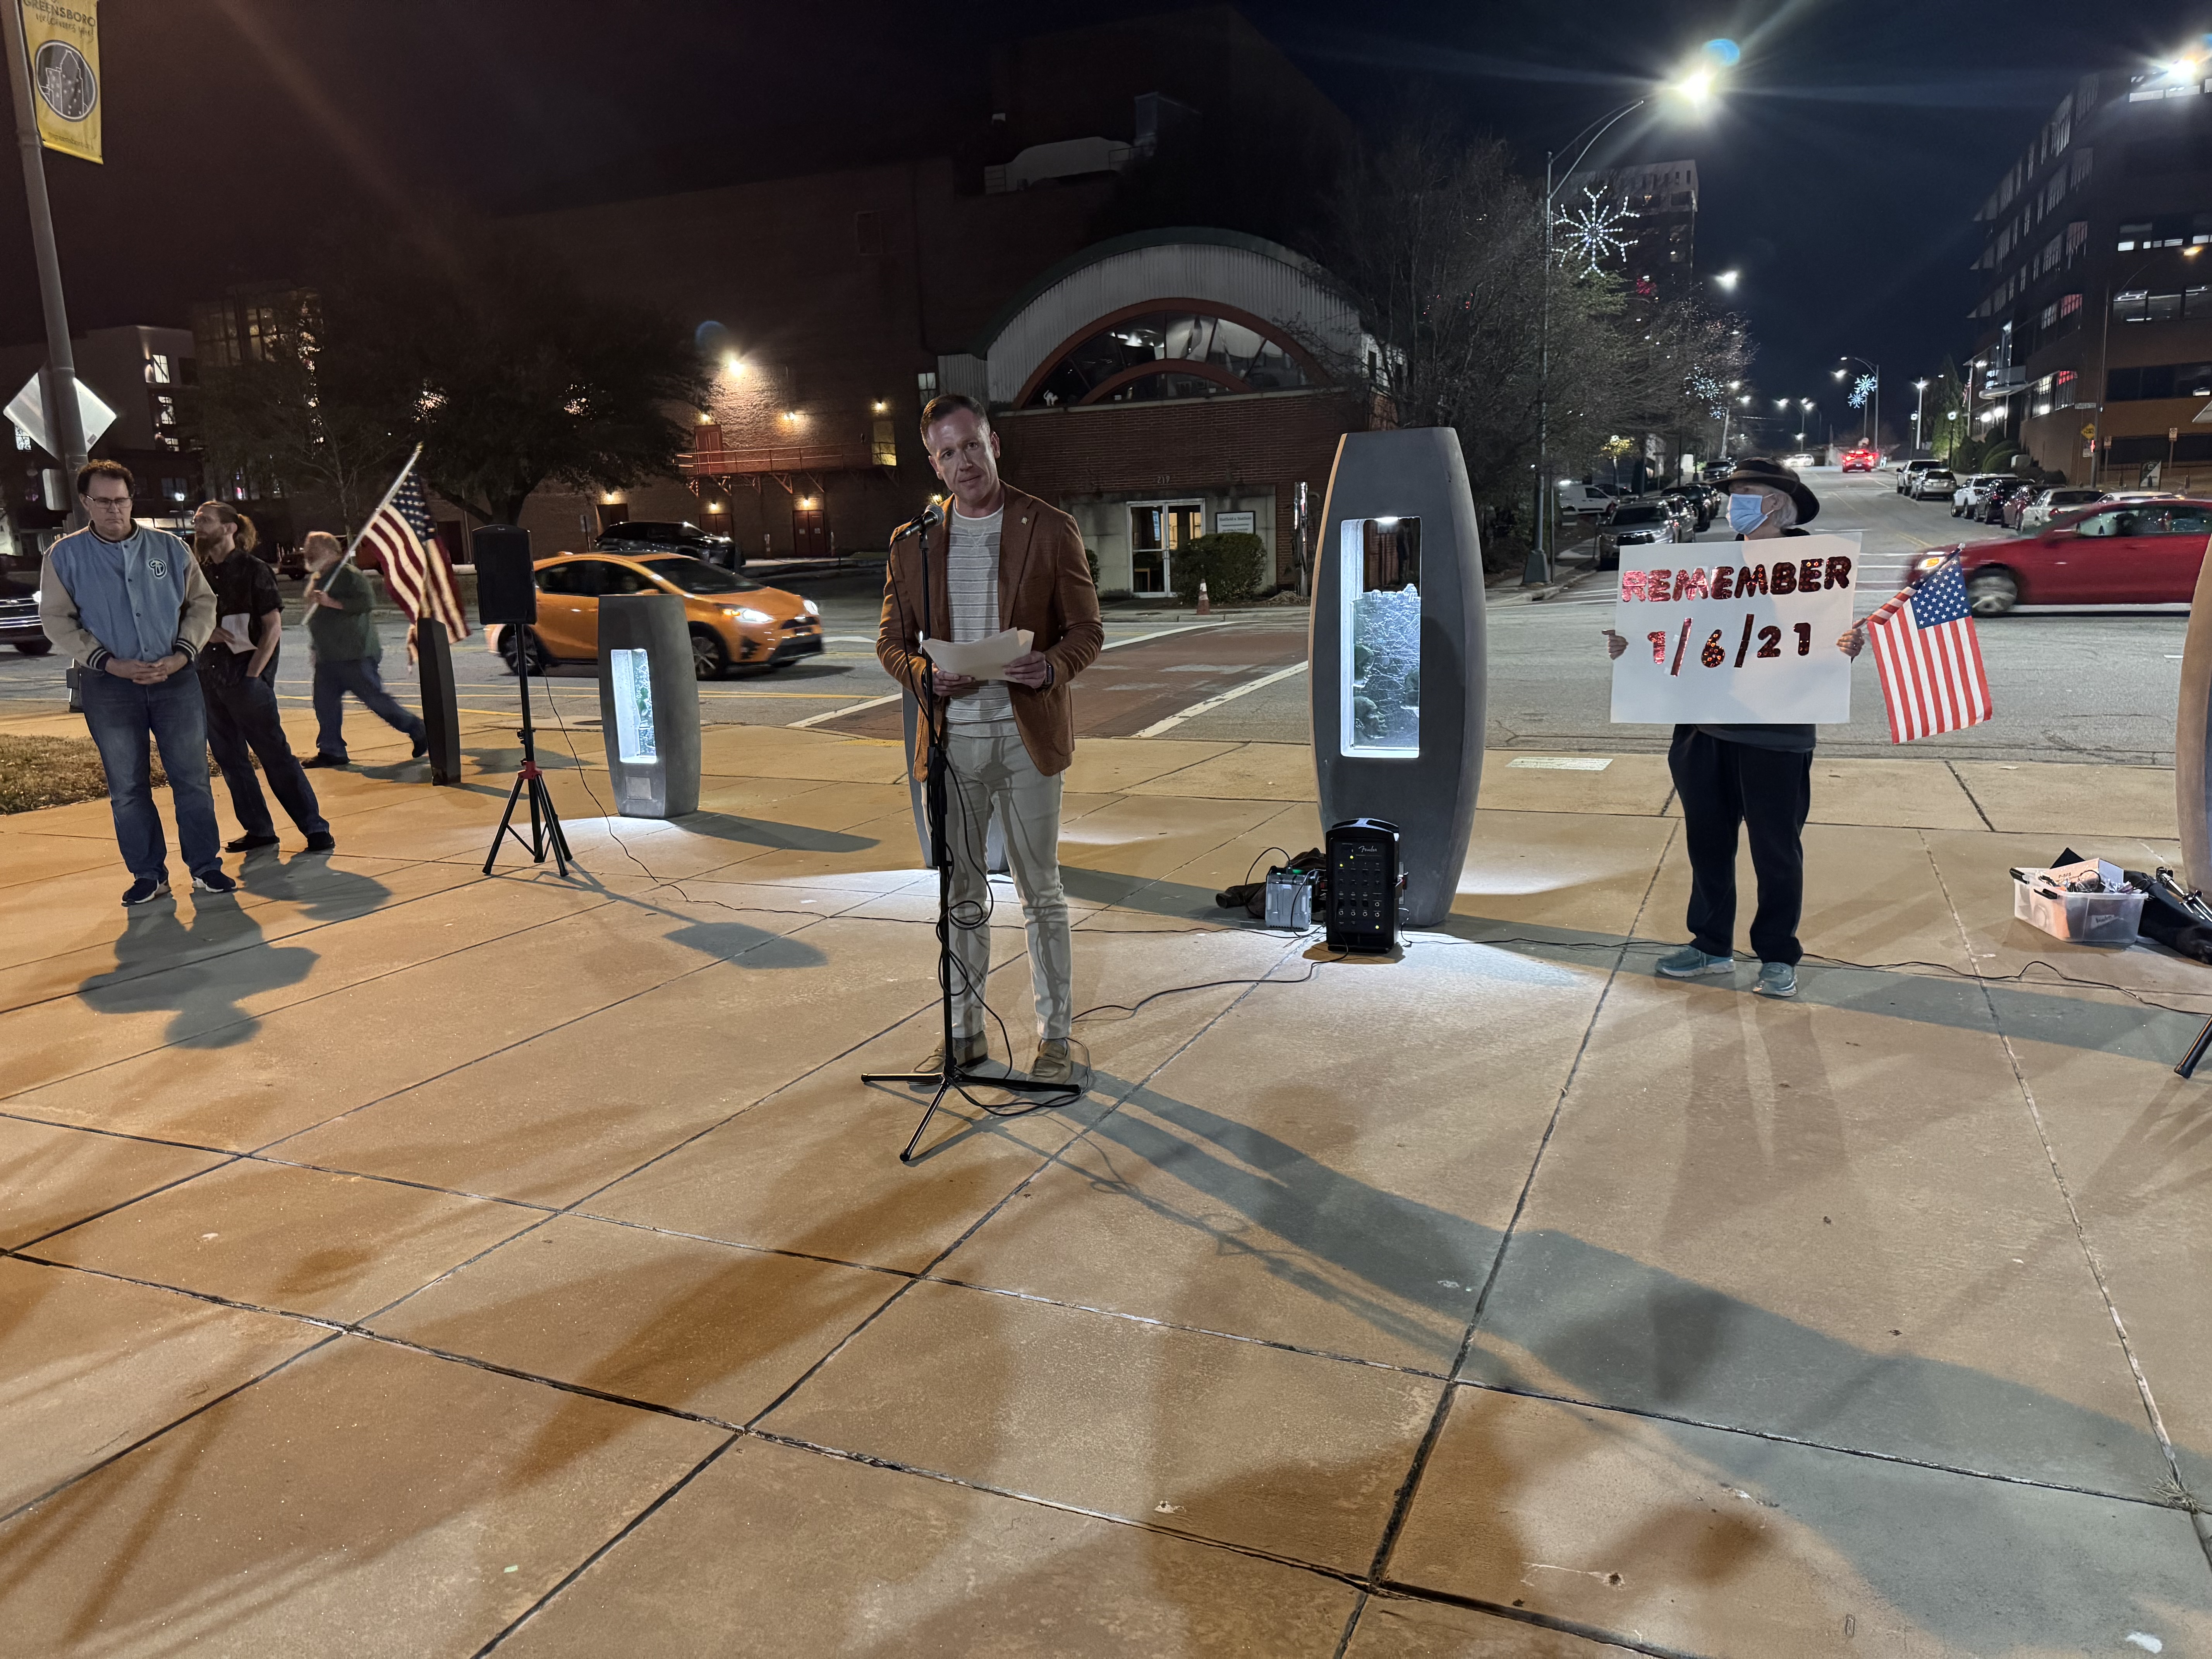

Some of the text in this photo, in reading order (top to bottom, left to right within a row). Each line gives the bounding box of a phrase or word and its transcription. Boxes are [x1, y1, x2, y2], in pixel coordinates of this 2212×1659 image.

[24, 0, 95, 27] GREENSBORO
[1157, 476, 1170, 484] 219
[1621, 556, 1852, 602] REMEMBER
[1647, 613, 1811, 677] 1/6/21
